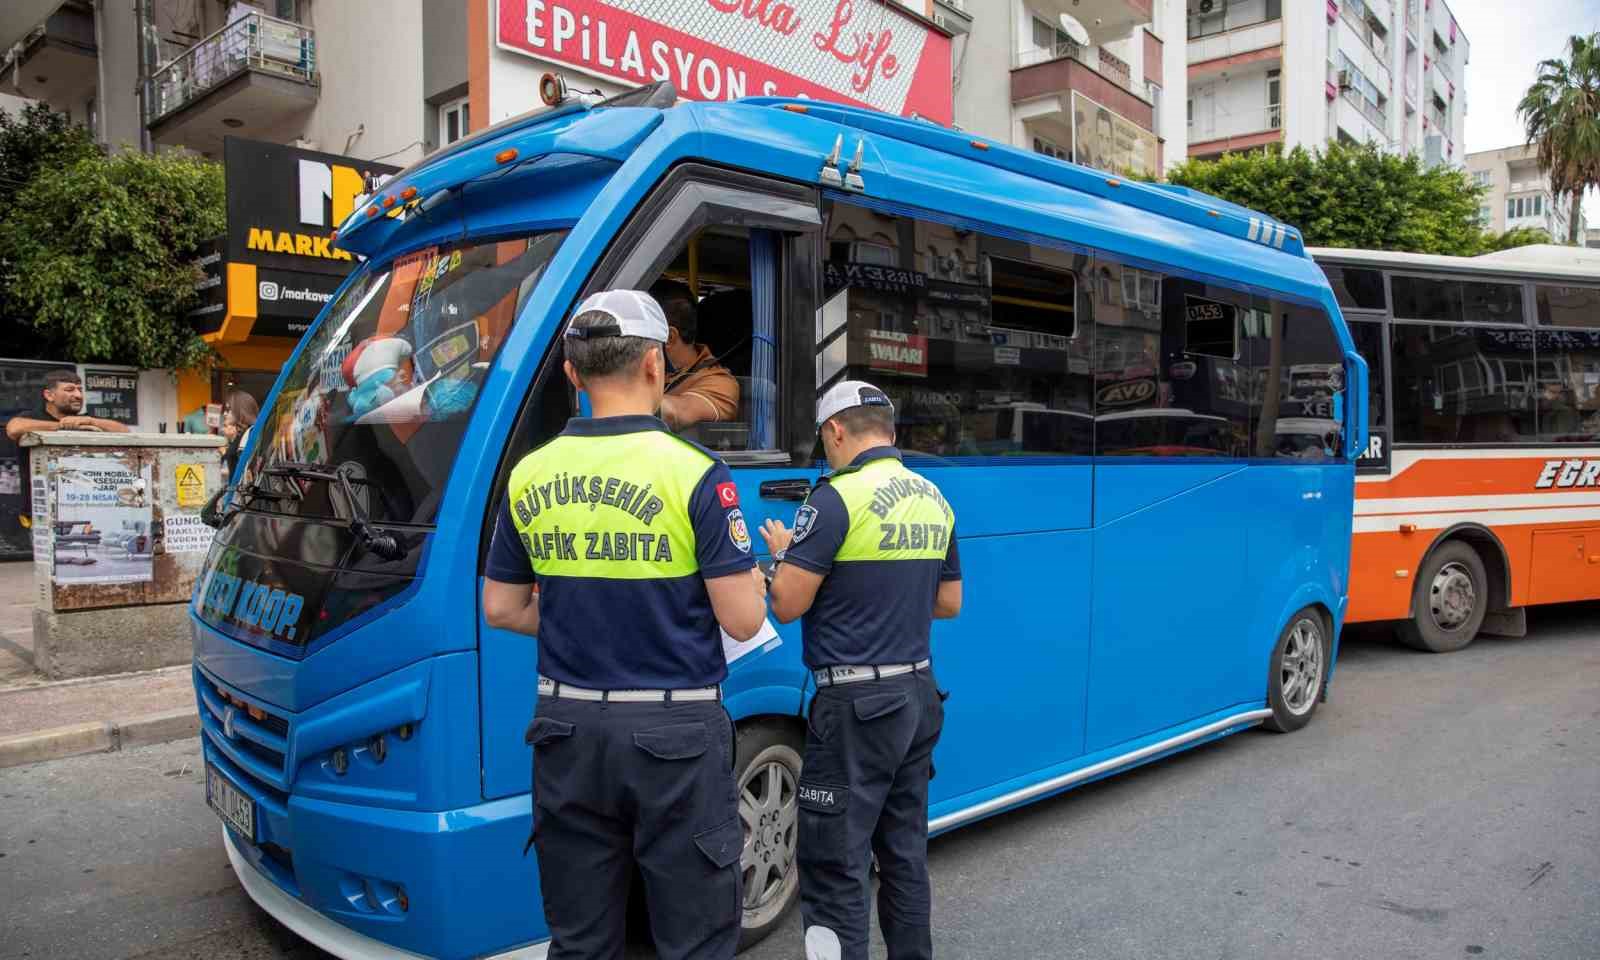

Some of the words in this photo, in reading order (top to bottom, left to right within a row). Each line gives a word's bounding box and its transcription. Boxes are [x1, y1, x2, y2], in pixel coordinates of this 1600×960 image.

[814, 0, 900, 93] Life
[515, 471, 665, 527] BÜYÜKŞEHİR
[584, 531, 673, 562] ZABITA
[799, 786, 835, 806] ZABITA
